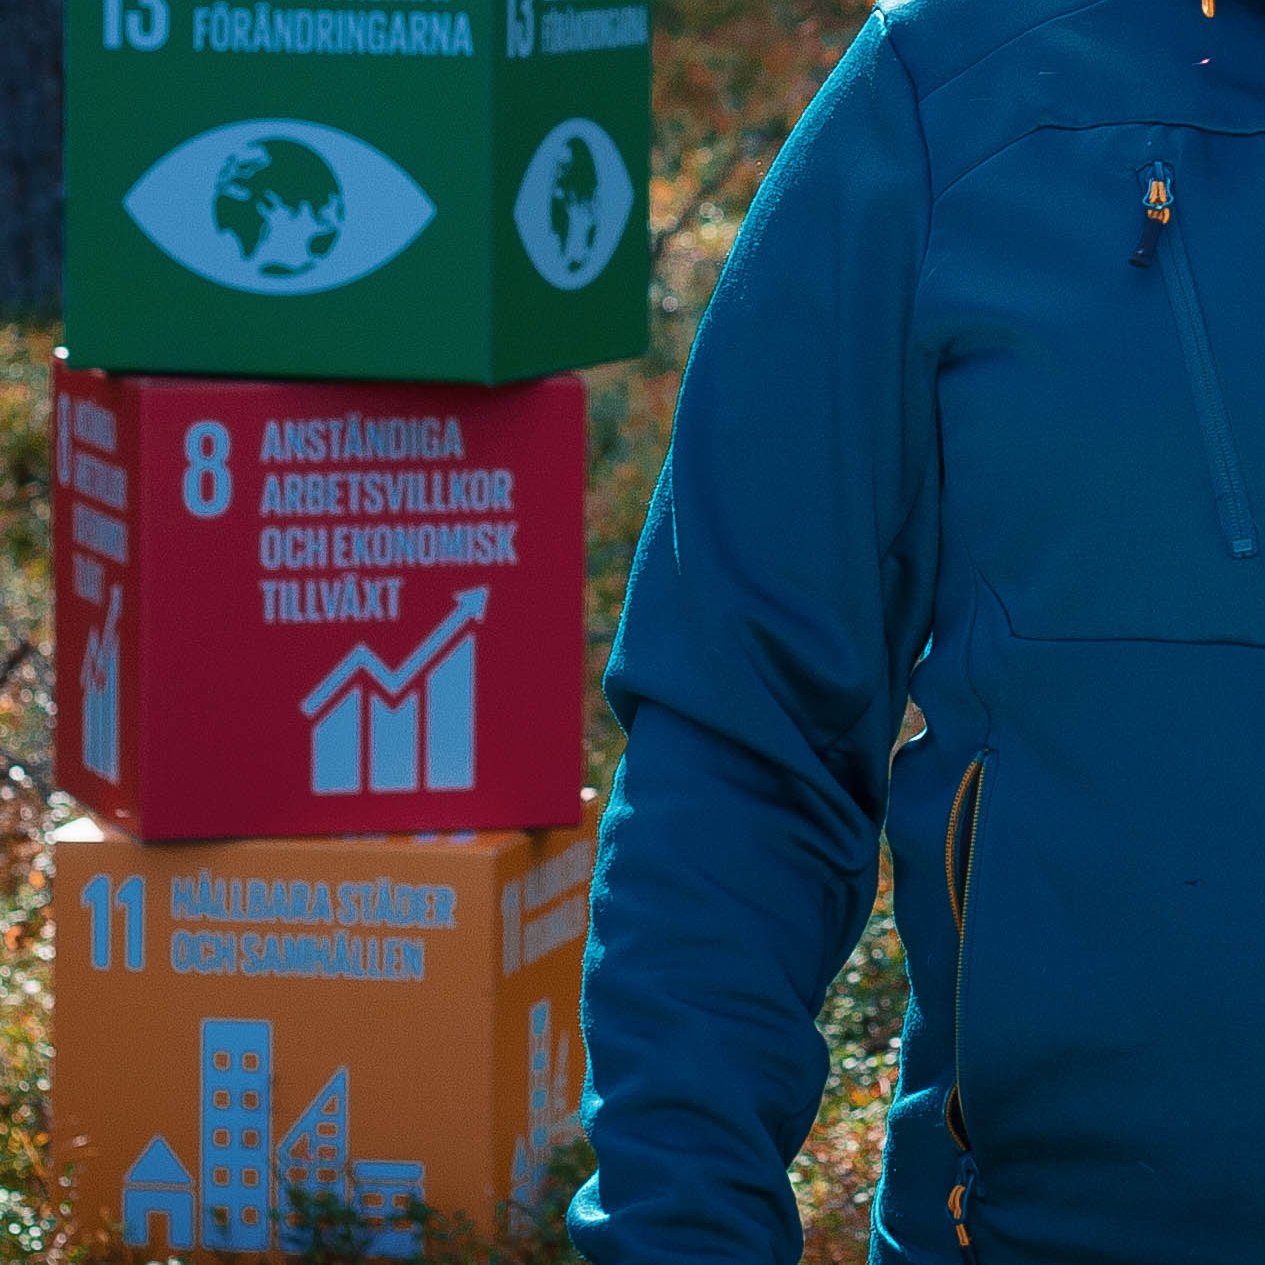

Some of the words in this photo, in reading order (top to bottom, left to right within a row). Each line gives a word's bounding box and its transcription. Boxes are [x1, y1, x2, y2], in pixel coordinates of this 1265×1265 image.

[193, 1, 474, 56] FÖRÄNDRINGARNA
[260, 411, 464, 462] ANSTÄNDIGA
[183, 420, 232, 518] 8
[260, 469, 514, 516] ARBETSVILLKOR
[259, 526, 328, 570] OCH
[333, 522, 519, 567] EKONOMISK
[259, 572, 403, 623] TILLVÄXT
[81, 874, 147, 972] 11
[171, 867, 333, 923] HÅLLBARA
[336, 876, 457, 929] STÄDER
[171, 930, 237, 974] OCH
[240, 930, 426, 982] SAMHÄLLEN
